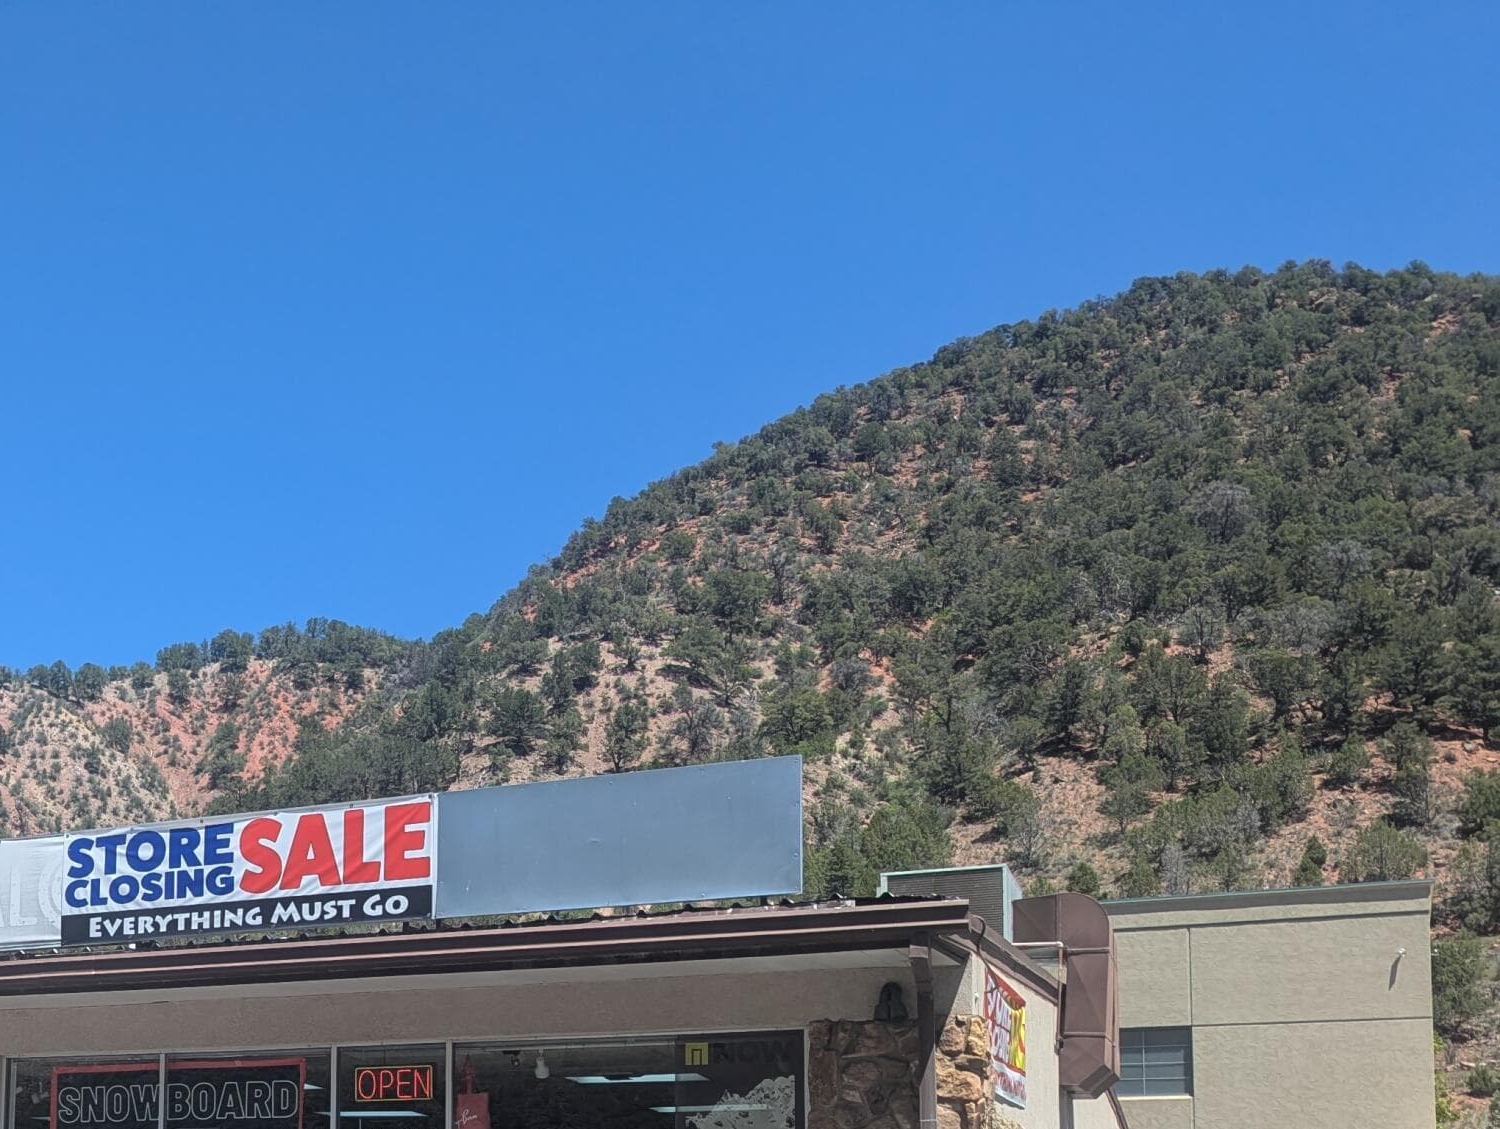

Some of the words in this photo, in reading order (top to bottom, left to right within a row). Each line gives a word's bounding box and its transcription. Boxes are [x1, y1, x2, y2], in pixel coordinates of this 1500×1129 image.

[67, 823, 234, 878] STORE
[239, 801, 431, 894] SALE
[65, 866, 234, 908] CLOSING
[89, 906, 262, 938] EVERYTHING
[271, 899, 356, 924] MUST
[363, 894, 409, 916] GO
[58, 1080, 298, 1123] SNOWBOARD
[359, 1069, 430, 1099] OPEN
